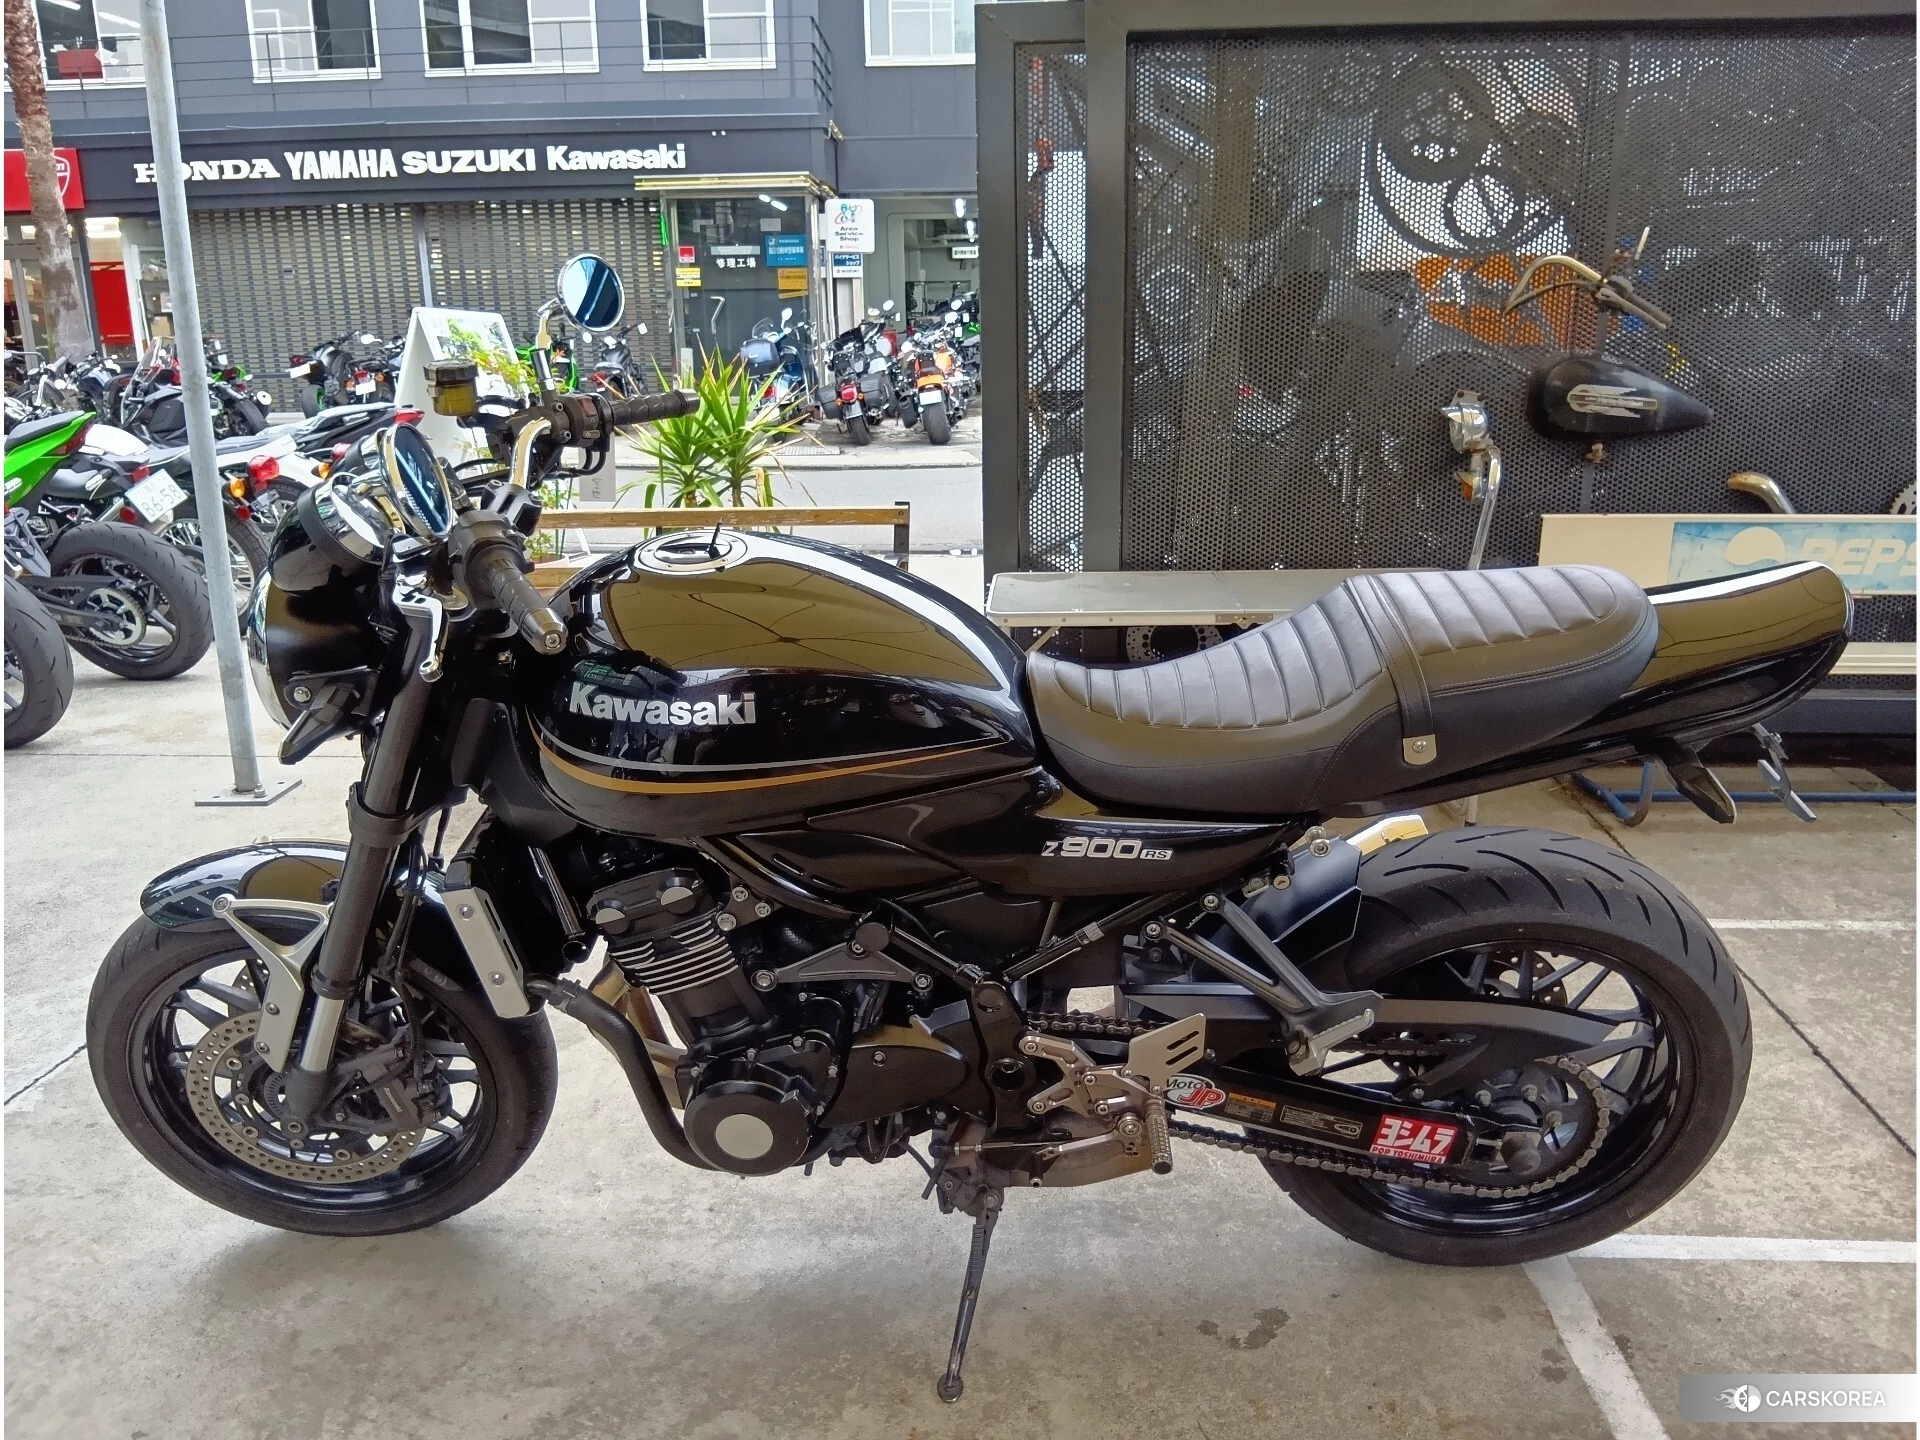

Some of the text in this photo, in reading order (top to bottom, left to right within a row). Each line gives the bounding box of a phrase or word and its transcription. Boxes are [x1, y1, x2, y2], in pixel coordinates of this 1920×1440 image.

[284, 149, 398, 180] YAMAHA
[402, 148, 537, 175] SUZUKI
[547, 143, 687, 171] Kawasaki
[716, 257, 757, 269] 修理工場
[141, 484, 182, 517] 86-58
[569, 681, 757, 726] Kawasaki
[1177, 1087, 1224, 1108] JP
[1376, 1117, 1455, 1155] ヨシムラ
[1371, 1146, 1444, 1163] POP YOSHIMURA
